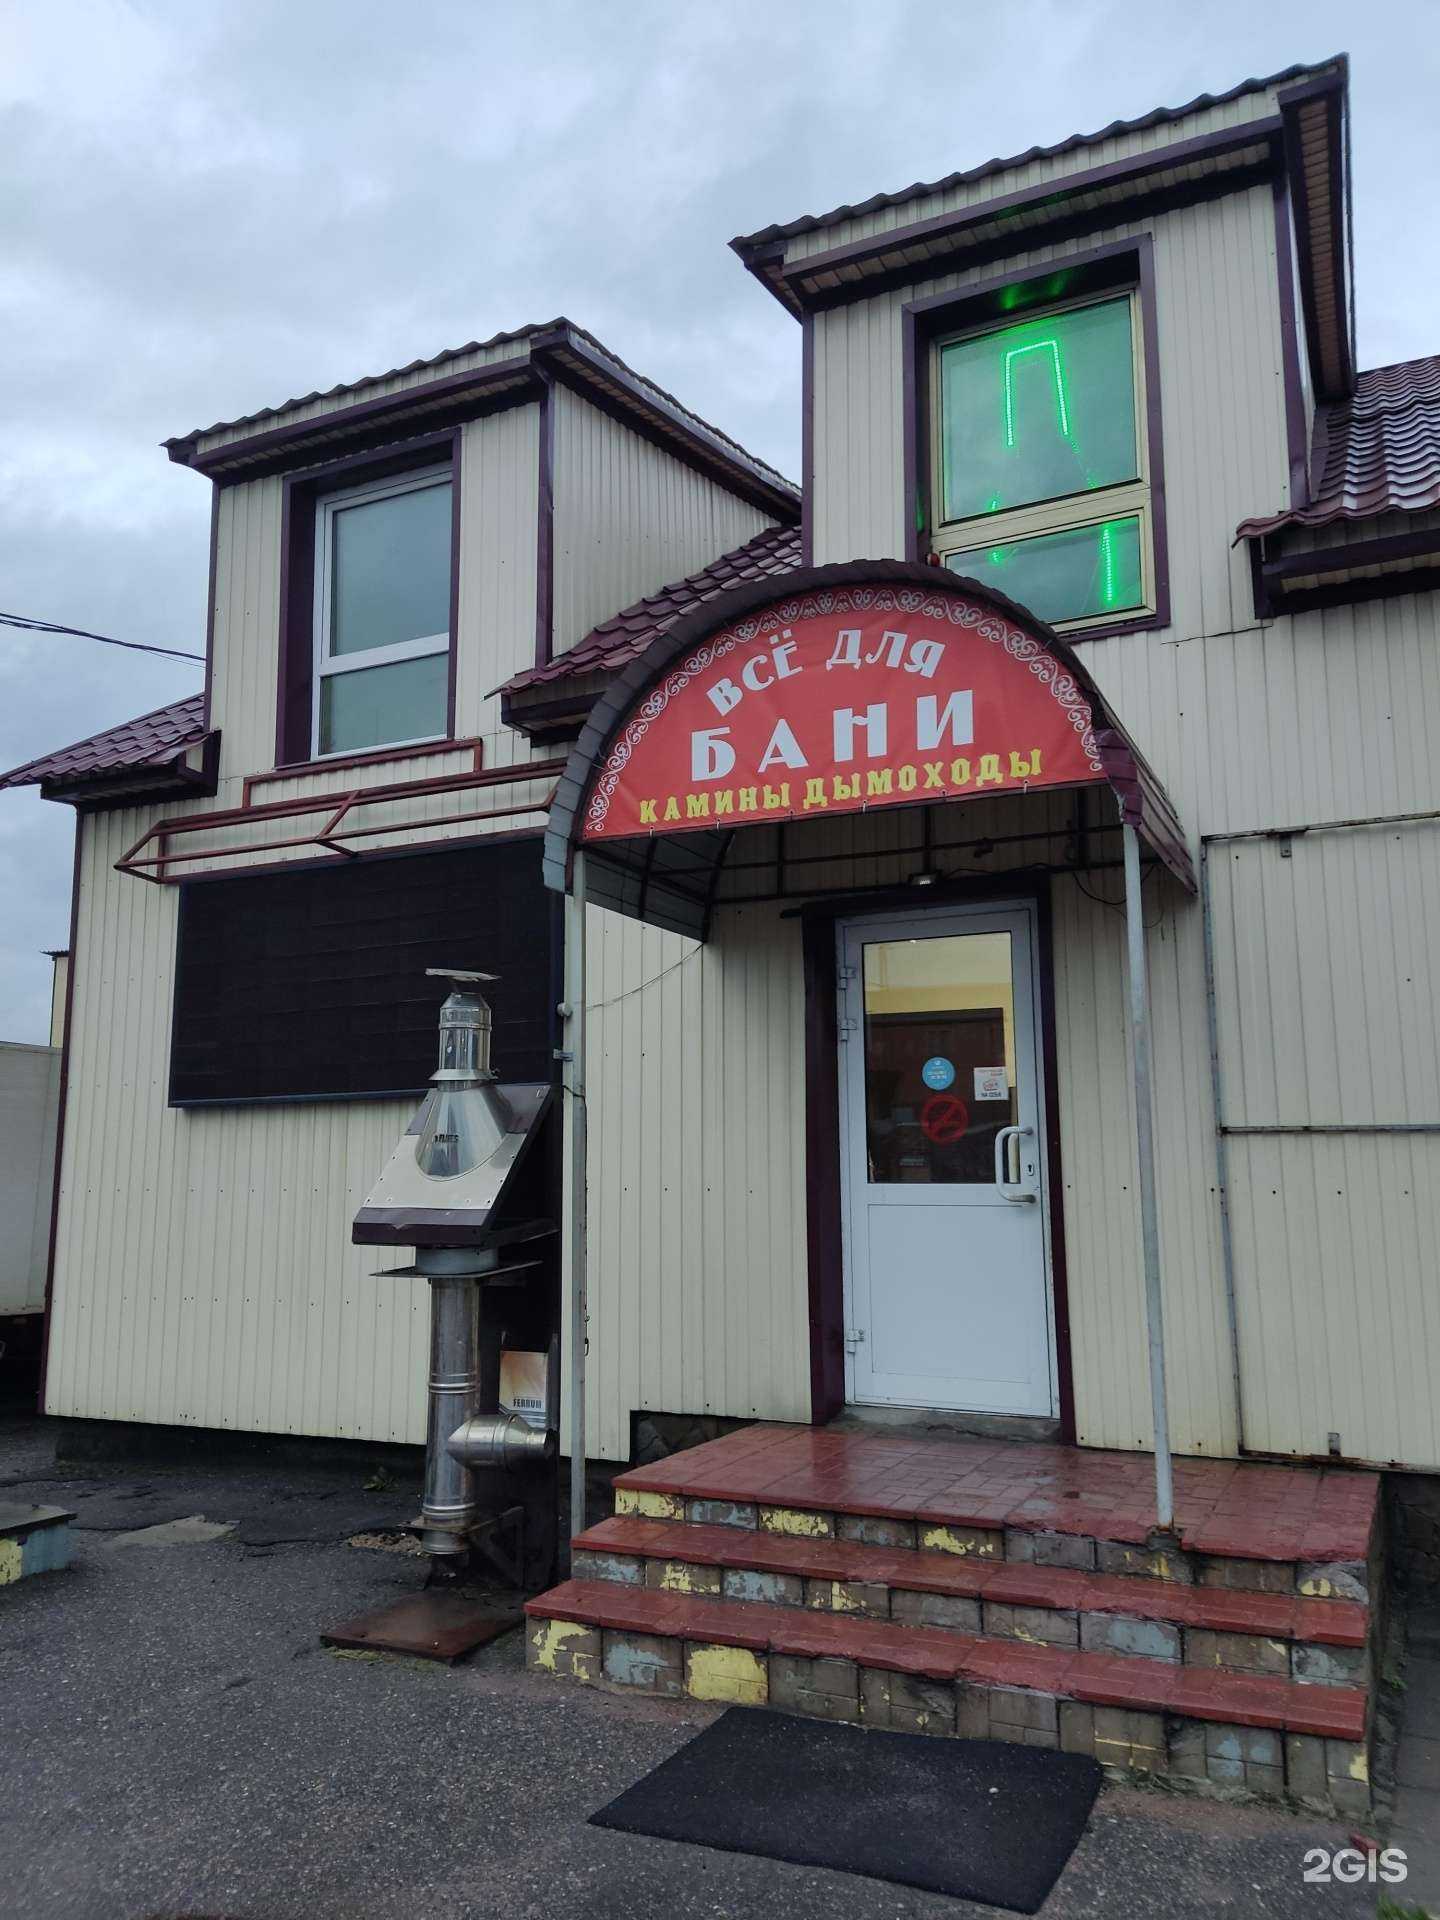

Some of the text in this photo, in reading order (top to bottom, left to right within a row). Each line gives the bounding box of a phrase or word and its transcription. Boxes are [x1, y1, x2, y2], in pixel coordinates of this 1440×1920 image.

[706, 629, 946, 717] ВСЁ ДЛЯ
[691, 689, 974, 782] БАНИ
[639, 748, 1043, 824] КАМИНЫ ДЫМОХОДЫ
